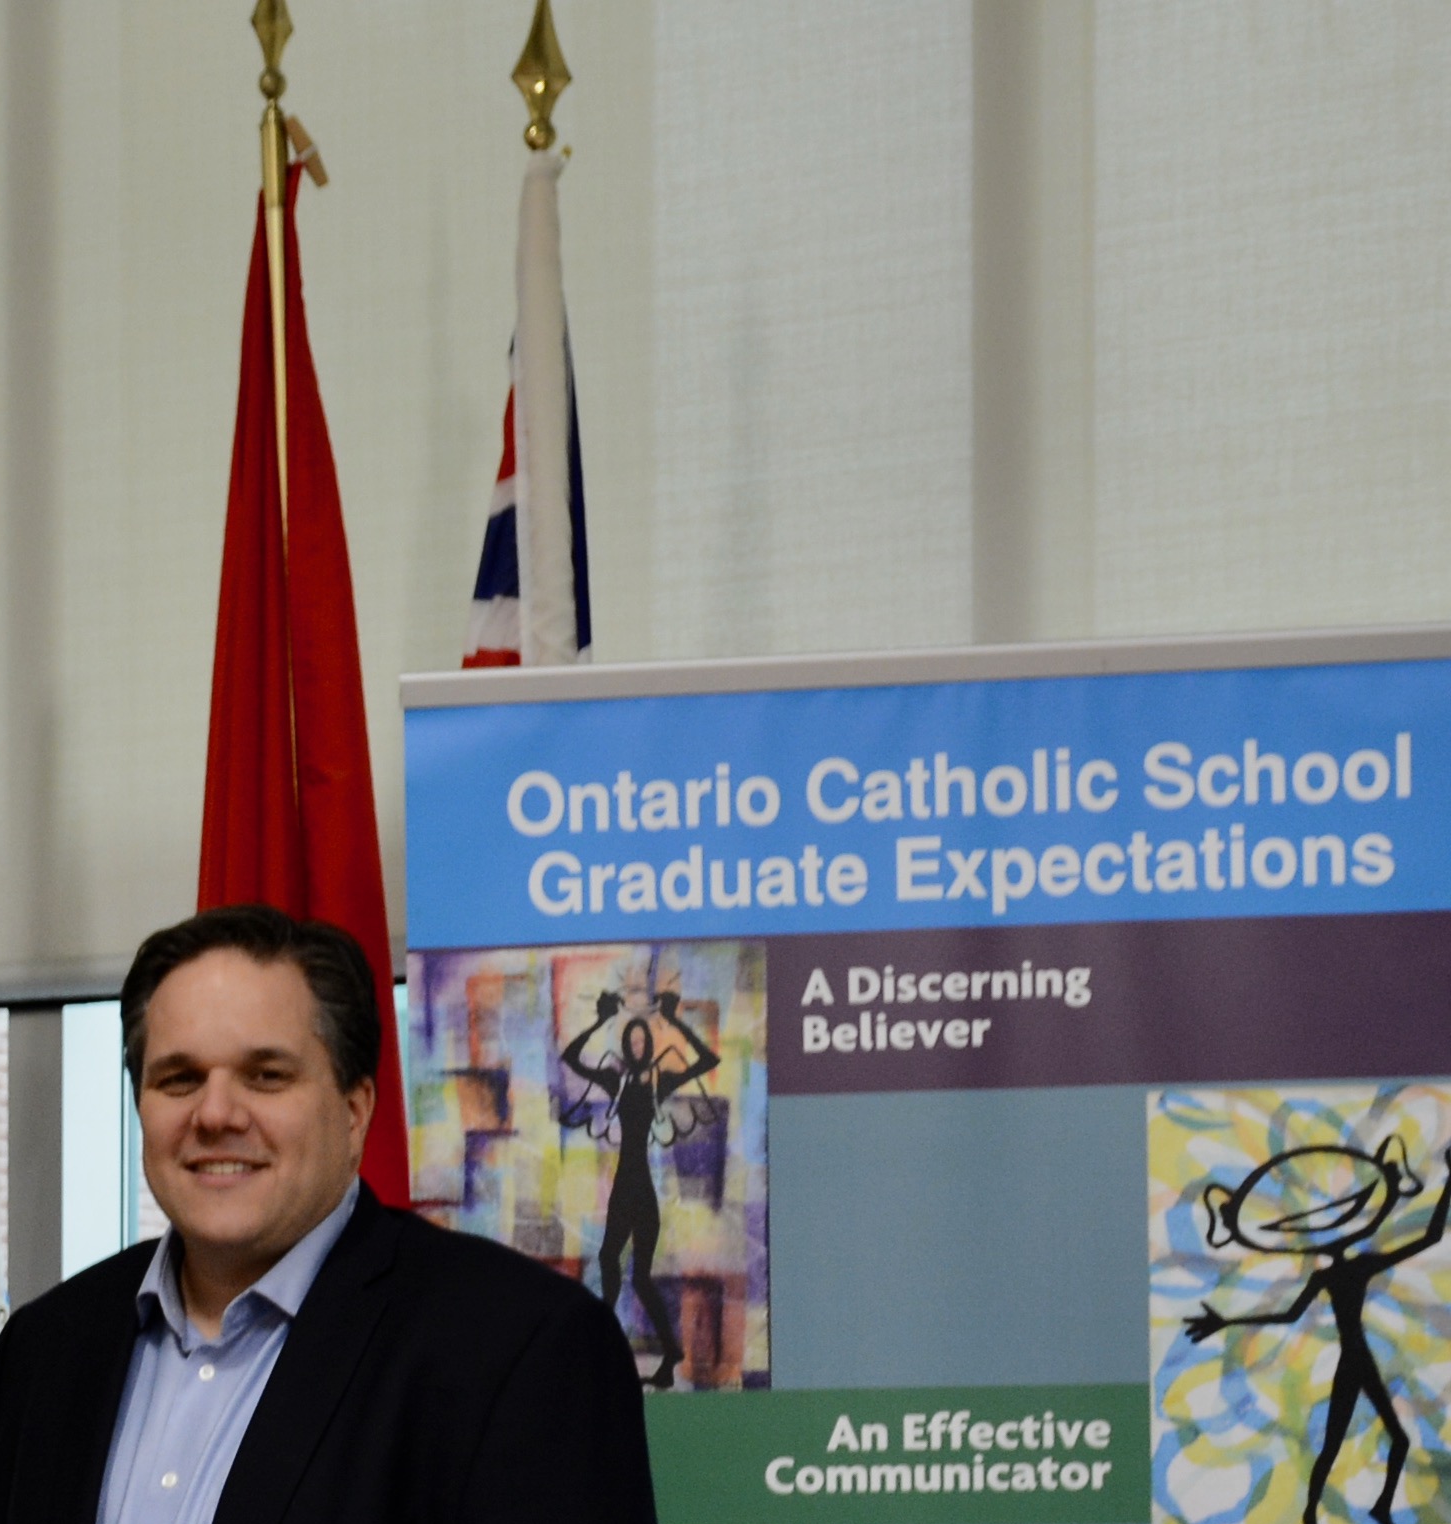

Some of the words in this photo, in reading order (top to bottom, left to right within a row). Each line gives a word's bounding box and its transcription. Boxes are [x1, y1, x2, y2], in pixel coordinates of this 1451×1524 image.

[507, 763, 780, 836] Ontario
[807, 748, 1118, 823] Catholic
[1144, 733, 1411, 809] School
[529, 845, 867, 916] Graduate
[896, 824, 1394, 915] Expectations
[802, 969, 834, 1005] A
[848, 961, 1091, 1007] Discerning
[803, 1011, 991, 1052] Believer
[827, 1415, 888, 1451] An
[903, 1411, 1110, 1450] Effective
[765, 1454, 1111, 1494] Communicator
